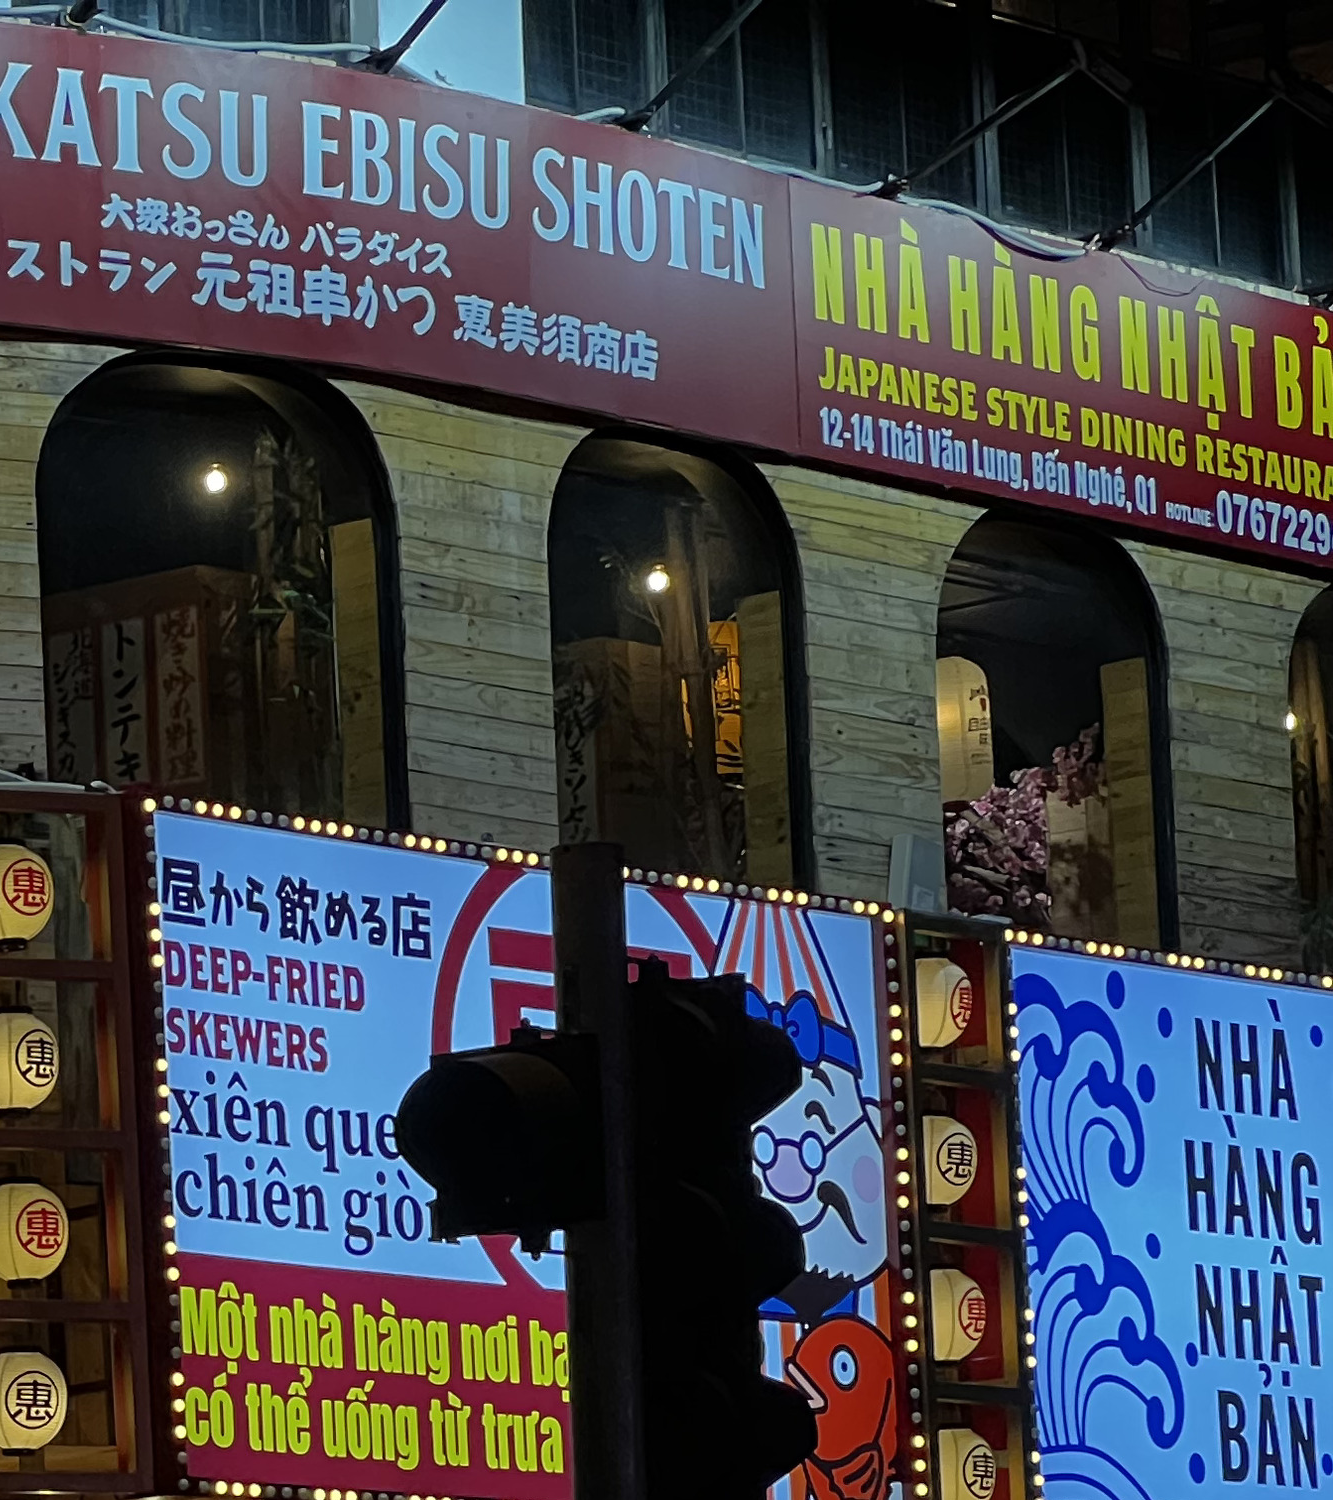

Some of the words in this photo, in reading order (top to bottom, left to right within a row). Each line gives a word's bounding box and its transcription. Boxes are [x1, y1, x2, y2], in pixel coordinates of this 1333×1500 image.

[300, 221, 453, 279] パラダイス
[301, 101, 511, 230] EBISU
[533, 146, 766, 290] SHOTEN
[191, 251, 436, 336] 元祖串かつ
[811, 218, 931, 344] NHÀ
[948, 241, 1102, 382] HÀNG
[1119, 295, 1255, 431] NHẬT
[818, 347, 978, 421] JAPANESE
[986, 388, 1071, 441] STYLE
[1081, 408, 1187, 467] DINING
[819, 407, 874, 454] 12-14
[878, 417, 925, 465] Thái
[928, 426, 968, 473] Văn
[971, 438, 1030, 492] Lung,
[1032, 447, 1071, 491] Bến
[1075, 459, 1133, 515] Nghé,
[1134, 477, 1157, 516] Q1
[1216, 489, 1333, 556] 0767229
[162, 857, 432, 960] 昼から飲める店
[163, 940, 366, 1012] DEEP-FRIED
[166, 1007, 329, 1073] SKEWERS
[1194, 998, 1299, 1121] NHÀ
[171, 1071, 291, 1148] xiên
[175, 1154, 329, 1232] chiên
[344, 1169, 460, 1255] giò
[1184, 1115, 1323, 1246] HÀNG
[180, 1281, 259, 1375] Một
[270, 1292, 343, 1369] nhà
[352, 1298, 450, 1386] hàng
[461, 1315, 521, 1384] nơi
[529, 1319, 570, 1403] bạ
[1195, 1244, 1324, 1388] NHẬT
[186, 1373, 235, 1448] có
[245, 1367, 311, 1455] thể
[322, 1380, 420, 1470] uống
[429, 1391, 471, 1467] từ
[482, 1403, 564, 1474] trưa
[1217, 1361, 1319, 1490] BẢN
